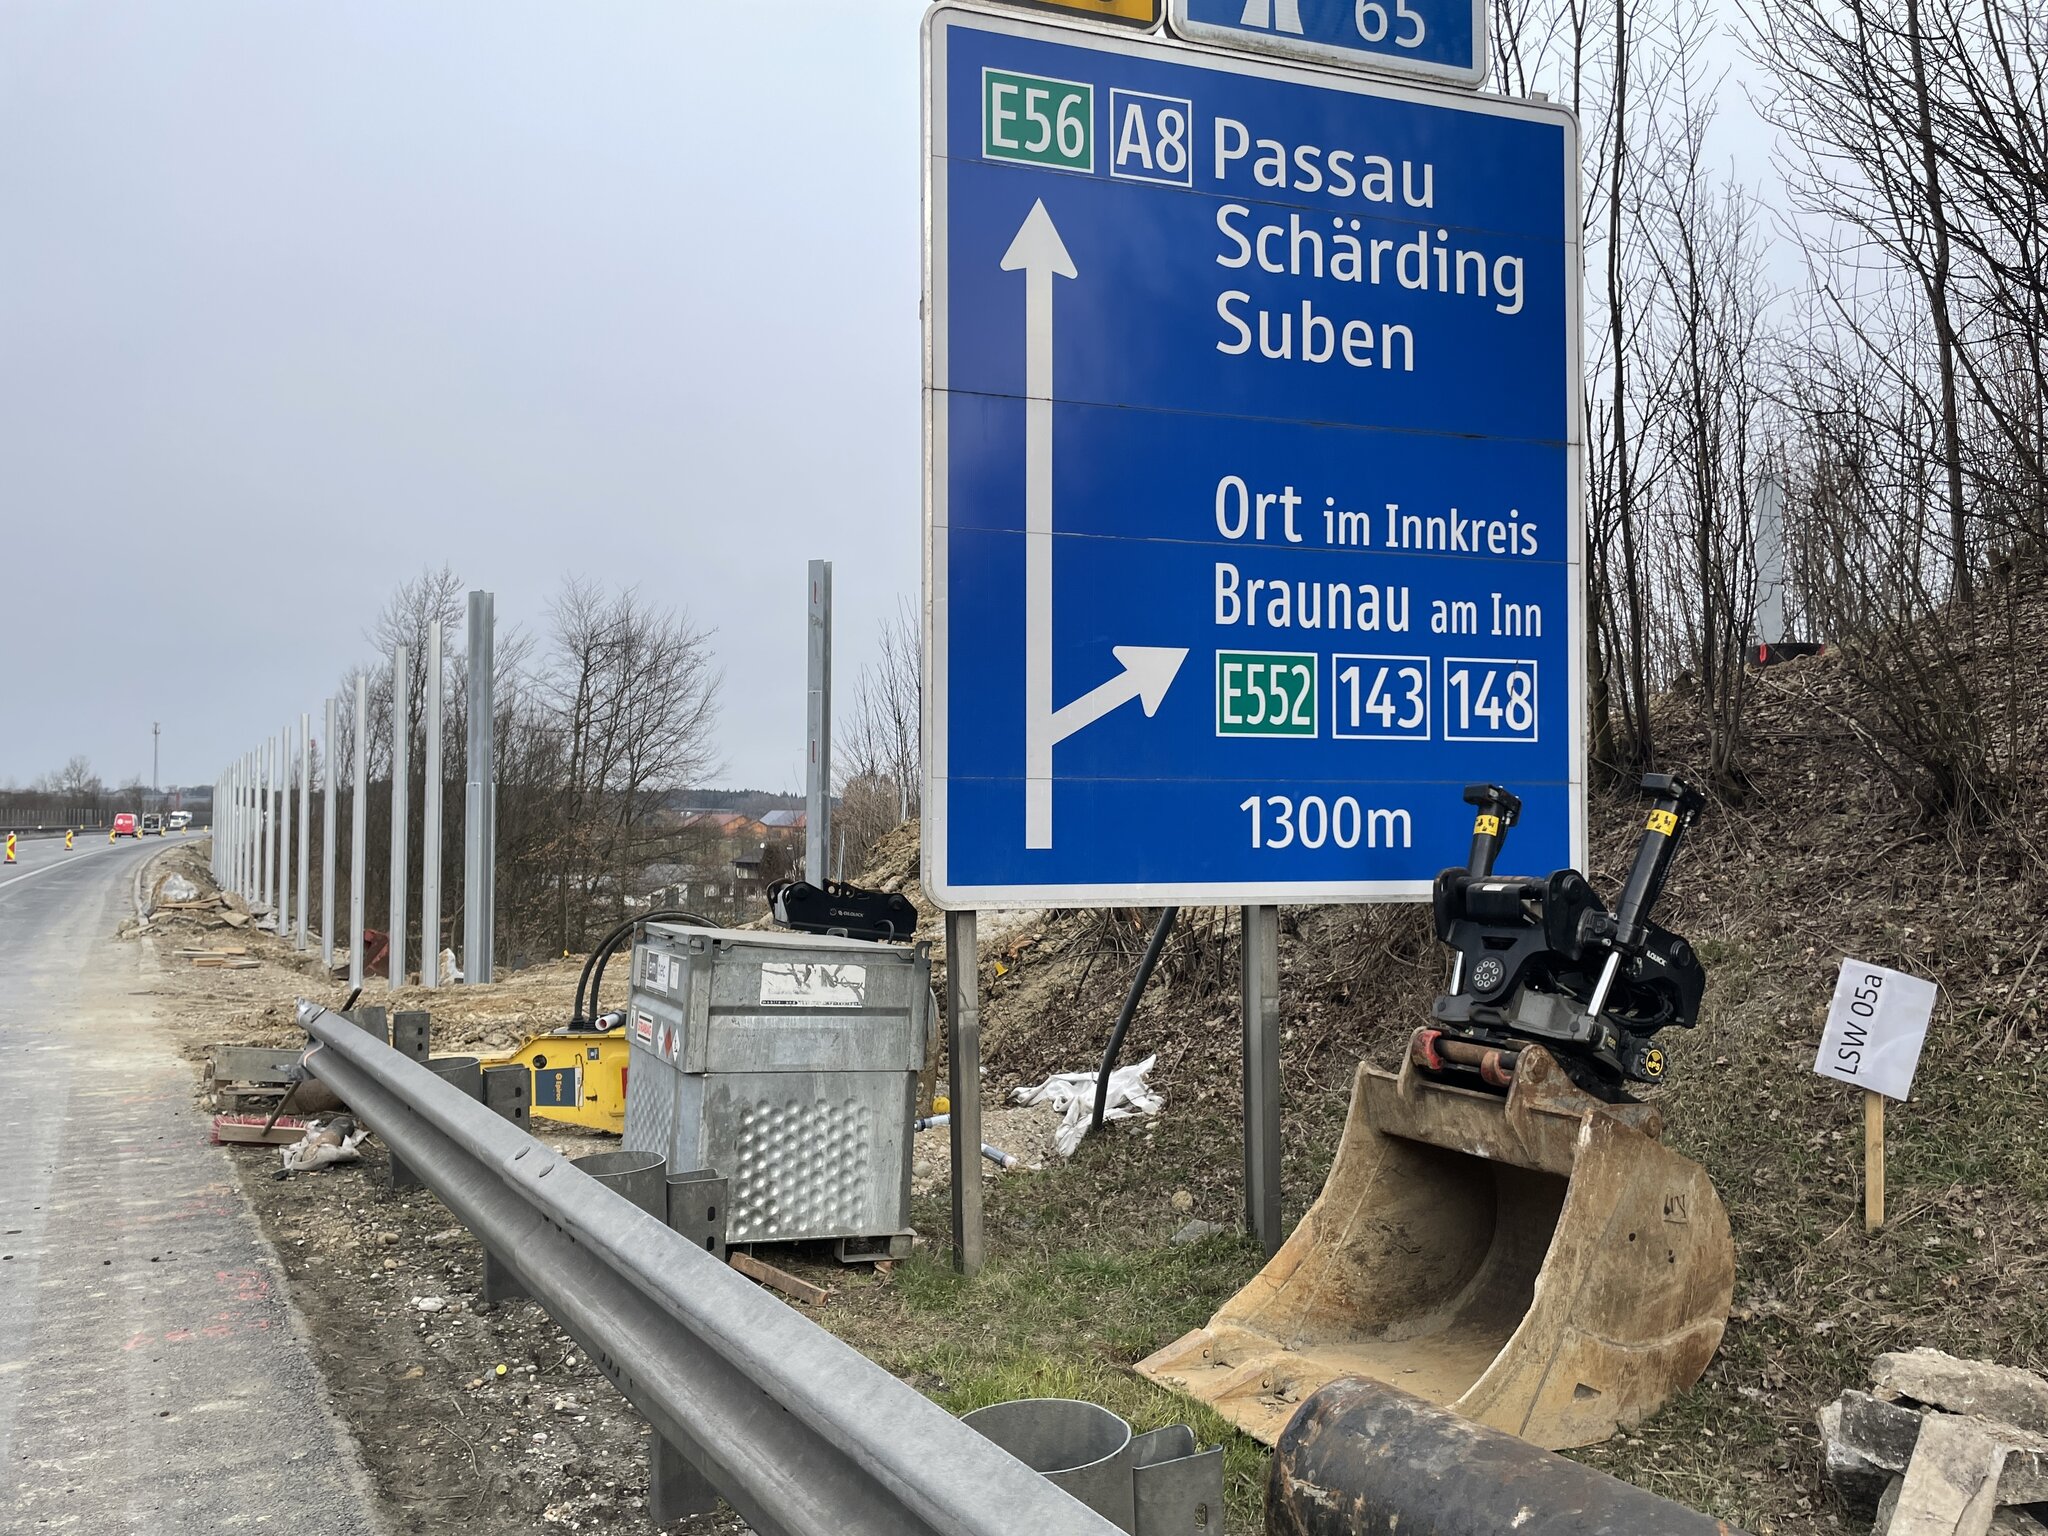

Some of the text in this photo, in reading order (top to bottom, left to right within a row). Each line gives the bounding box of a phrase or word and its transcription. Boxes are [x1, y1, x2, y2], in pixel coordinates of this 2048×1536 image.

[1355, 0, 1426, 48] 65
[991, 81, 1085, 158] E56
[1116, 103, 1187, 174] A8
[1214, 117, 1433, 209] Passau
[1216, 204, 1524, 315] Schärding
[1216, 290, 1414, 372] Suben
[1216, 475, 1538, 556] Ort im Innkreis
[1215, 562, 1541, 637] Braunau am Inn
[1223, 662, 1311, 726] E552
[1340, 667, 1424, 729] 143
[1450, 669, 1532, 731] 148
[1240, 796, 1412, 849] 1300m
[1834, 974, 1883, 1075] LSW 05a
